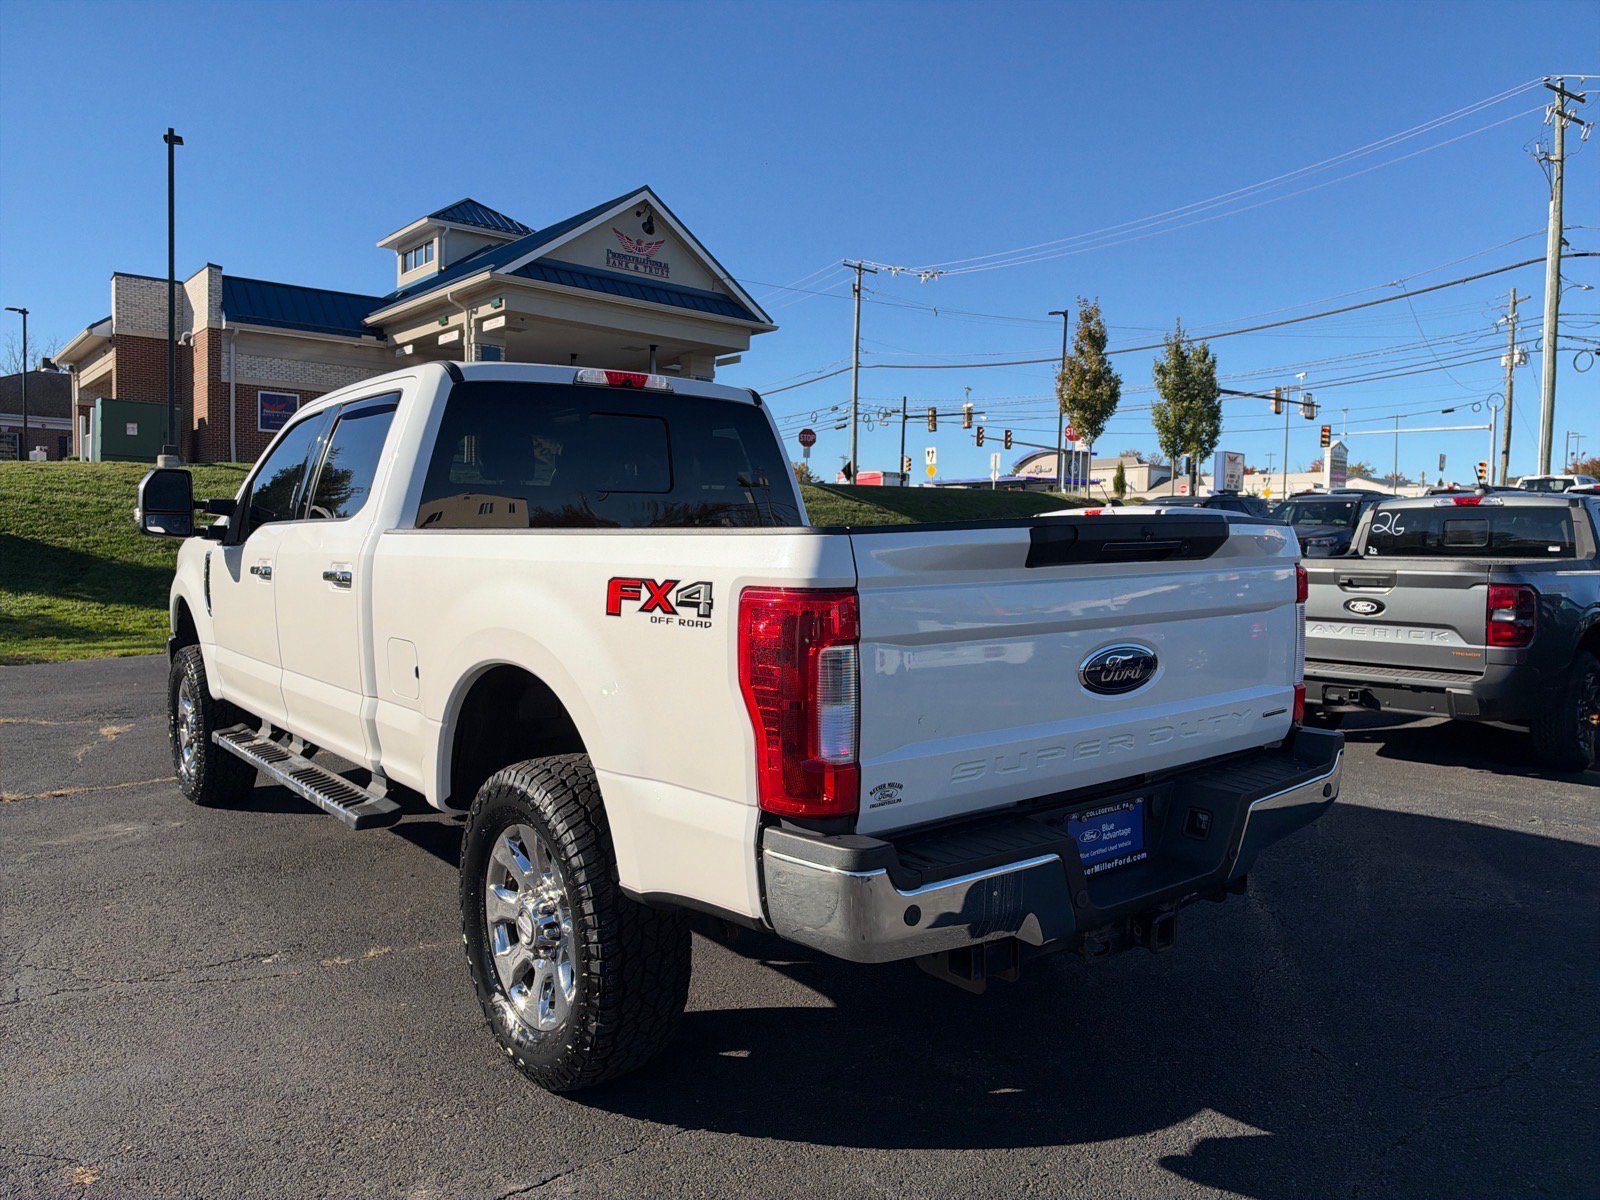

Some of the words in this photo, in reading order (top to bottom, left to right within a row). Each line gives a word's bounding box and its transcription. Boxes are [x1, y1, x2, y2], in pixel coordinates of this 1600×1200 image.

[606, 257, 630, 269] BANK
[644, 265, 670, 277] TRUST
[1372, 512, 1405, 536] 26
[605, 576, 714, 618] FX4
[650, 615, 674, 625] OFF
[678, 618, 712, 629] ROAD
[1310, 624, 1450, 642] AVERICK
[1101, 654, 1144, 682] Ford
[951, 733, 1136, 784] SUPER
[1148, 708, 1252, 746] DUTY
[1083, 831, 1097, 841] Ford
[1102, 827, 1132, 841] Advantage
[1102, 823, 1115, 831] Blue
[1107, 843, 1118, 852] Used
